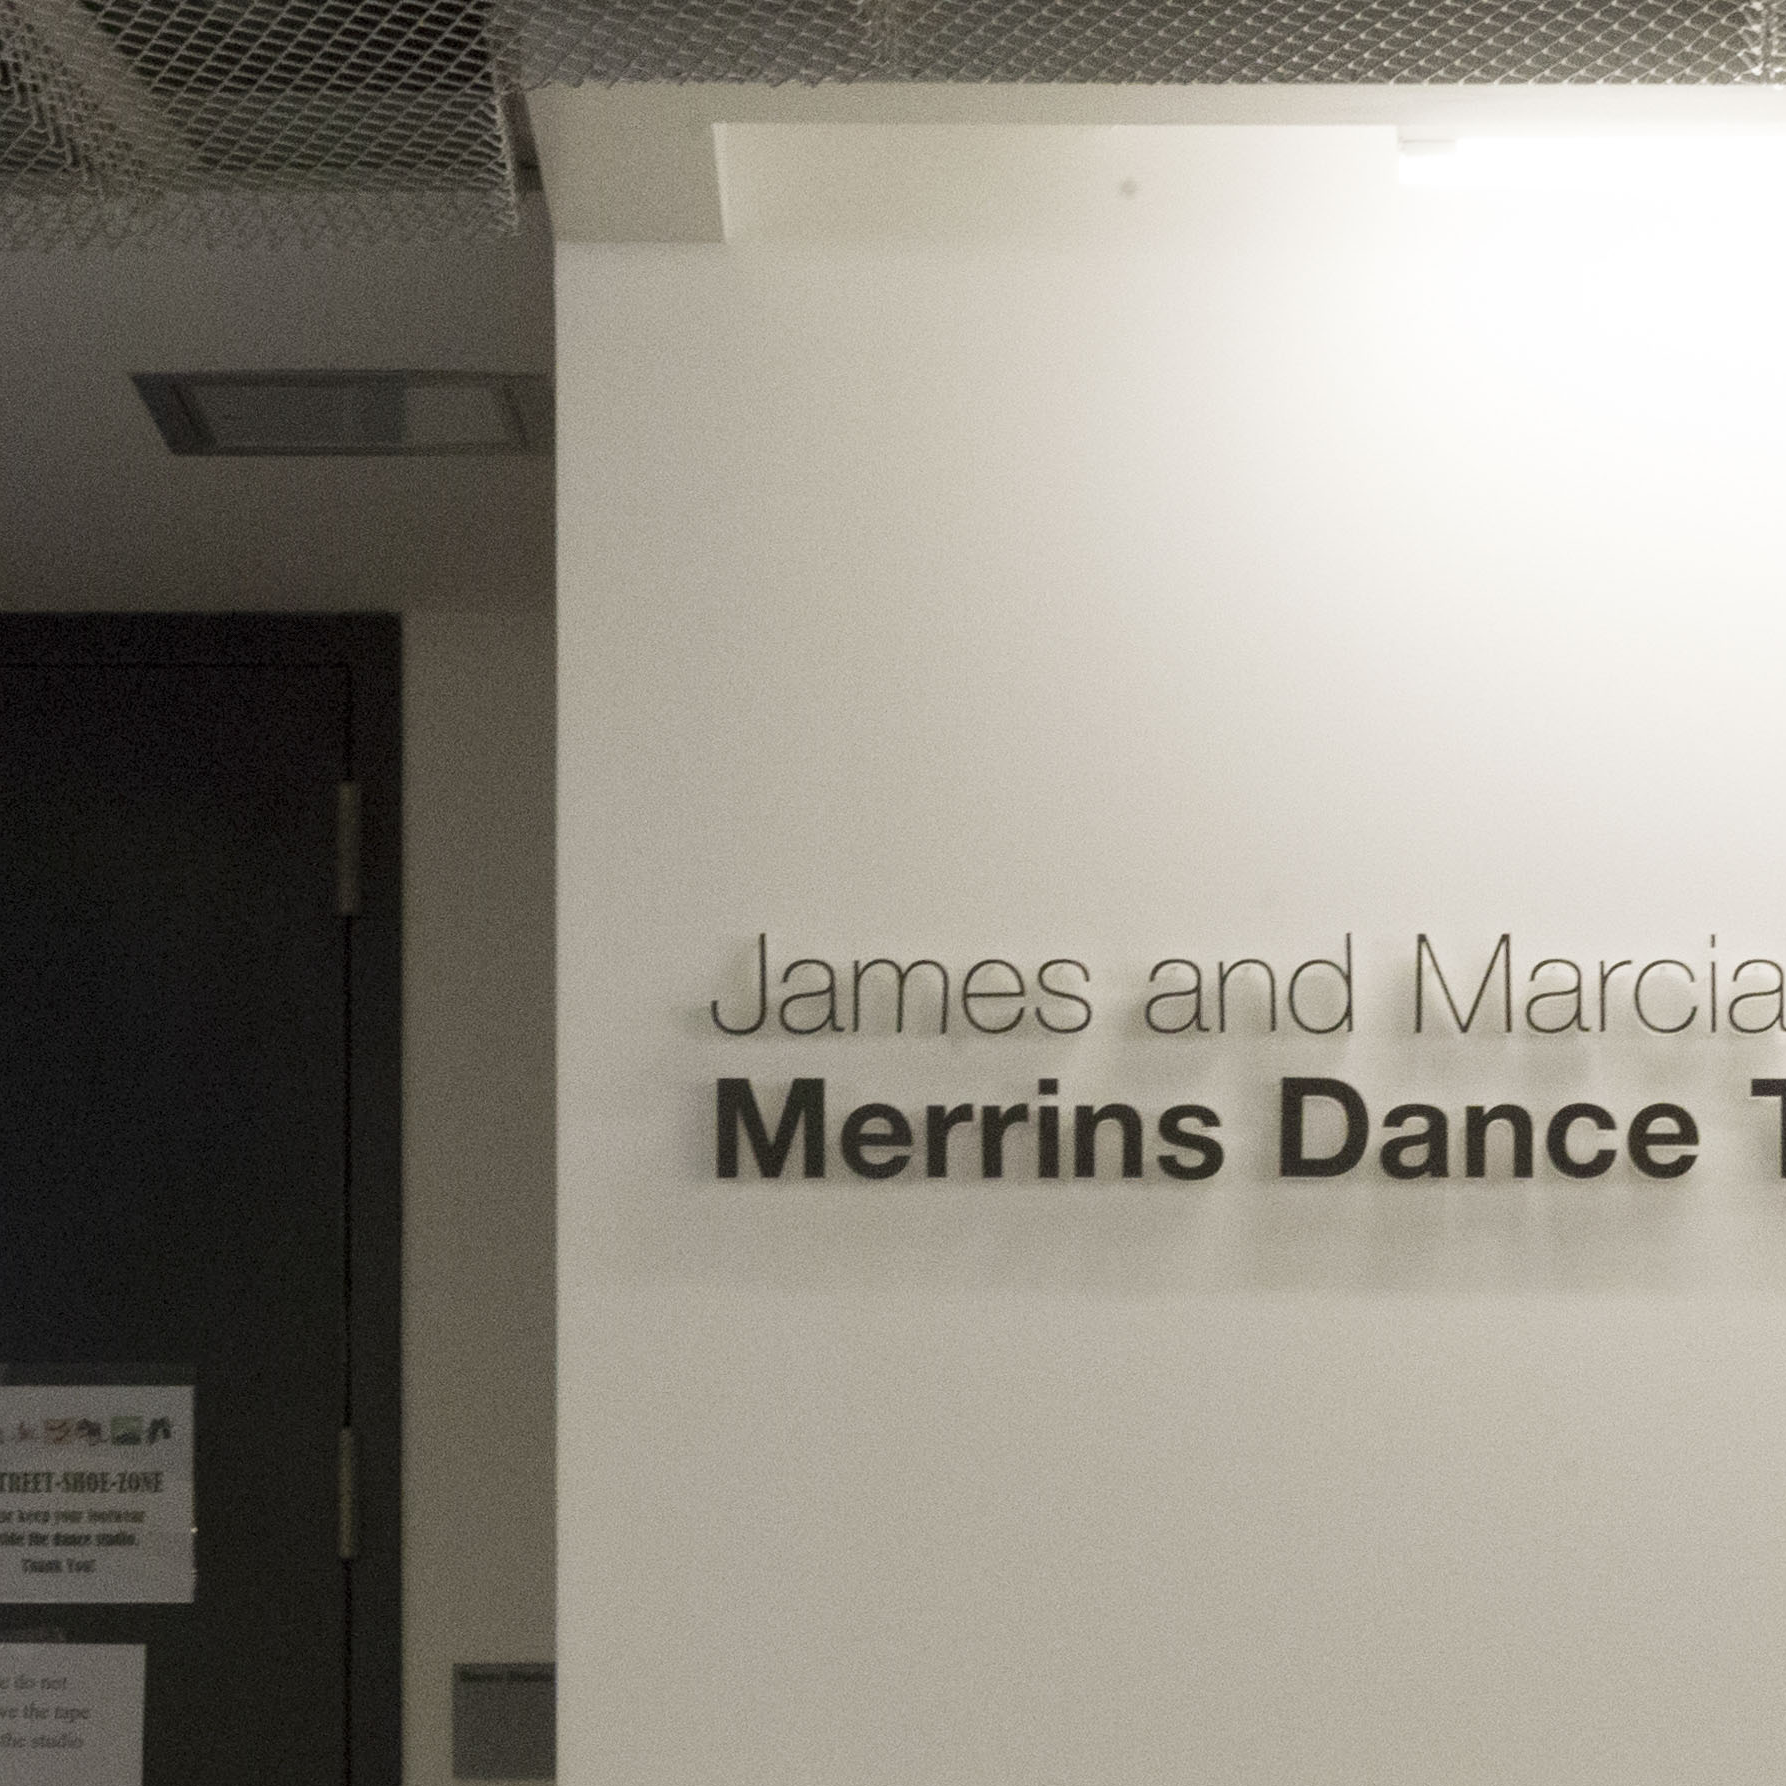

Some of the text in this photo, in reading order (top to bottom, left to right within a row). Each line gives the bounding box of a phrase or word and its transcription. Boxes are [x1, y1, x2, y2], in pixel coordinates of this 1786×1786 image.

[708, 934, 1093, 1036] James
[1142, 934, 1354, 1036] and
[714, 1077, 1225, 1181] Merrins
[1278, 1076, 1700, 1181] Dance
[14, 1674, 35, 1690] do
[40, 1677, 68, 1690] not
[22, 1702, 50, 1720] the
[53, 1706, 91, 1724] tape
[0, 1731, 26, 1749] the
[30, 1732, 84, 1749] studio
